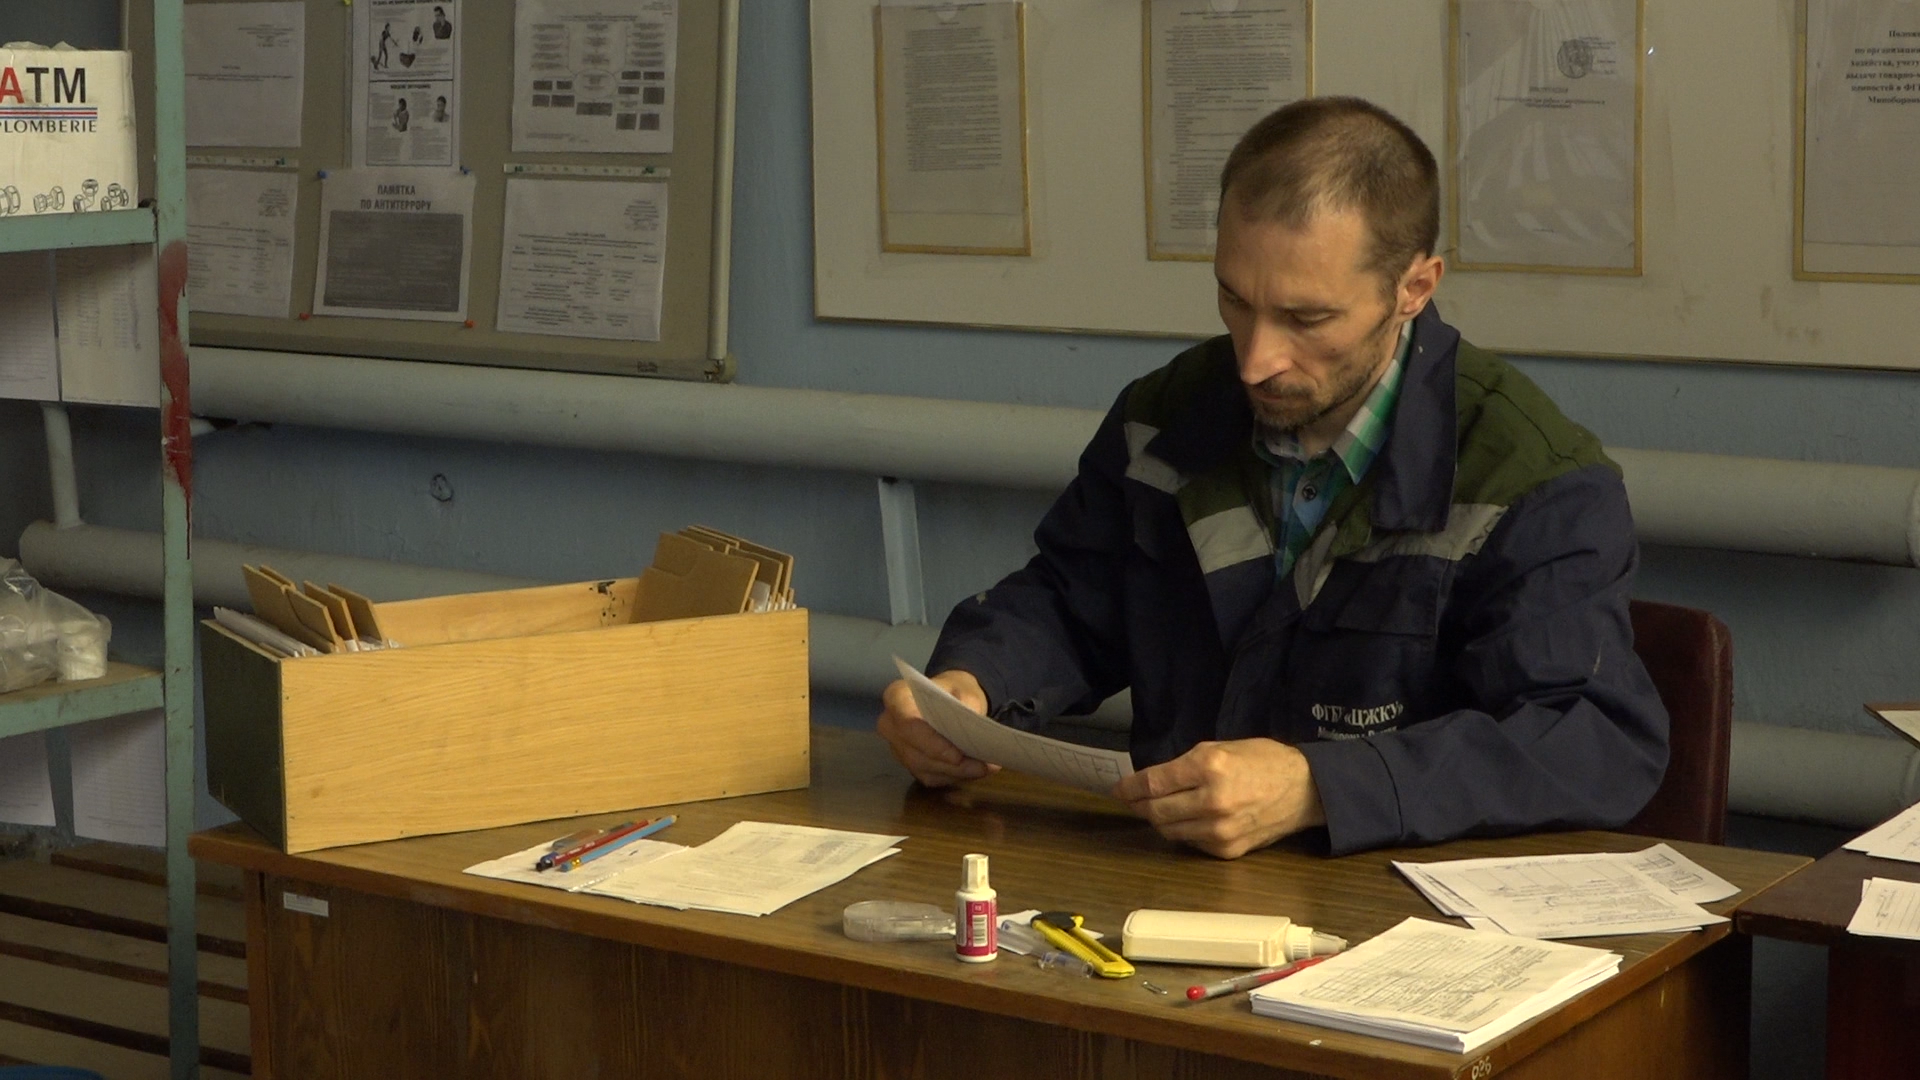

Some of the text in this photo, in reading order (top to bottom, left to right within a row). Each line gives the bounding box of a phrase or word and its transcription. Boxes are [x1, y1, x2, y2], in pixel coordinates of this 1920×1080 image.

[0, 66, 87, 104] ATM
[0, 118, 97, 134] LOMBERIE
[377, 184, 416, 196] ПАМЯТКА
[360, 199, 432, 211] ПО АНТИТЕРРОРУ
